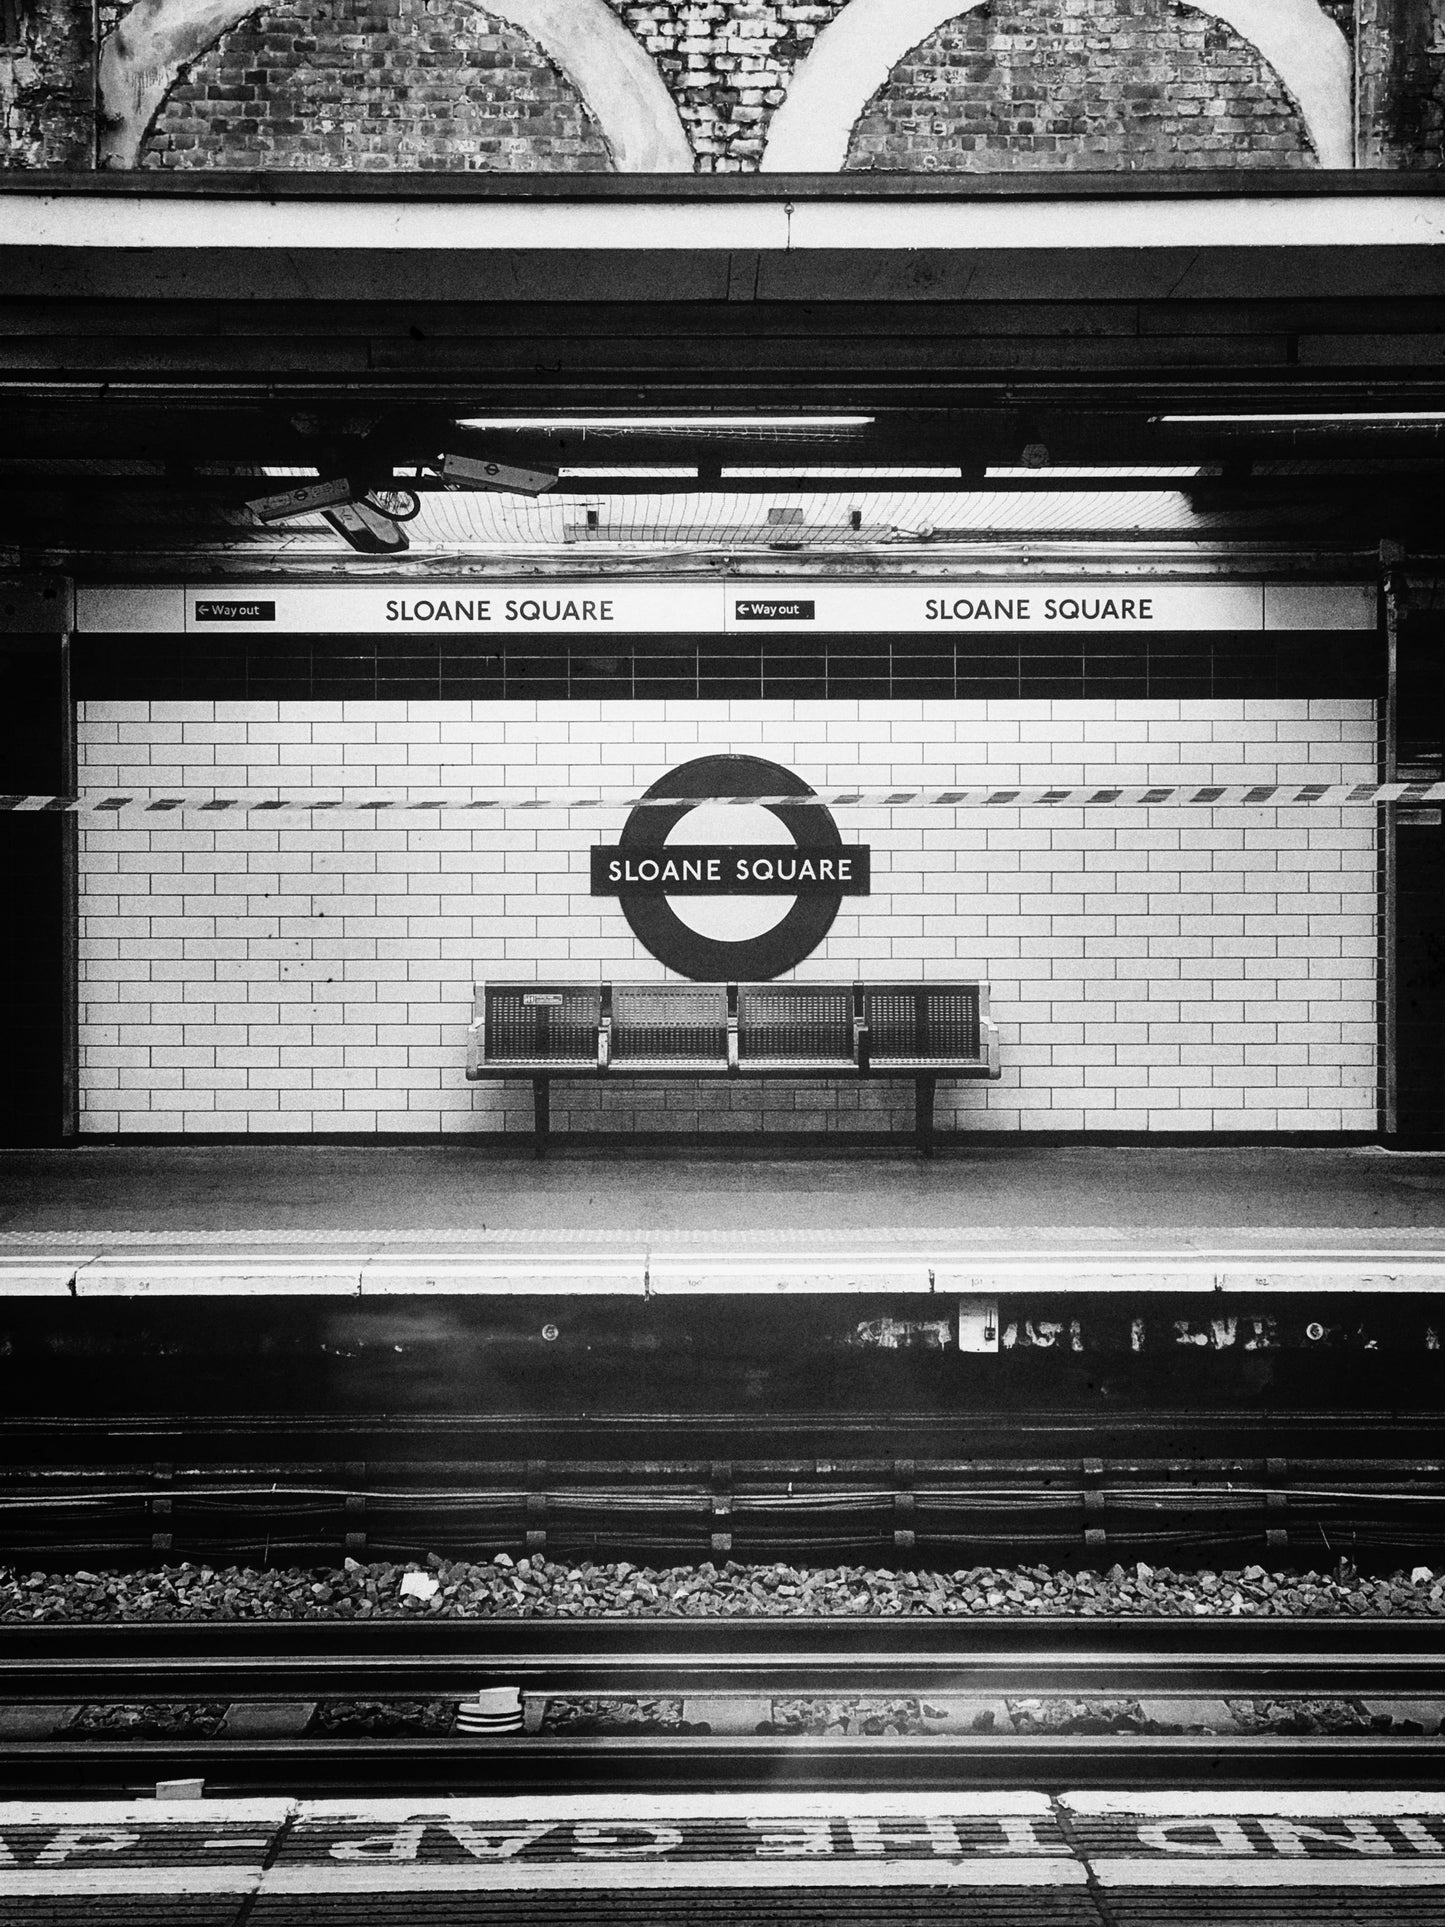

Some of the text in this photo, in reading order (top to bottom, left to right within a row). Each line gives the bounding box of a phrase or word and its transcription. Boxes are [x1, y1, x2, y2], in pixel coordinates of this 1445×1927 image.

[211, 604, 260, 617] Way out
[385, 600, 614, 621] SLOANE SQUARE
[750, 603, 800, 617] Way out
[925, 598, 1153, 620] SLOANE SQUARE
[608, 858, 852, 881] SLOANE SQUARE
[329, 1817, 1445, 1860] IND THE GAP
